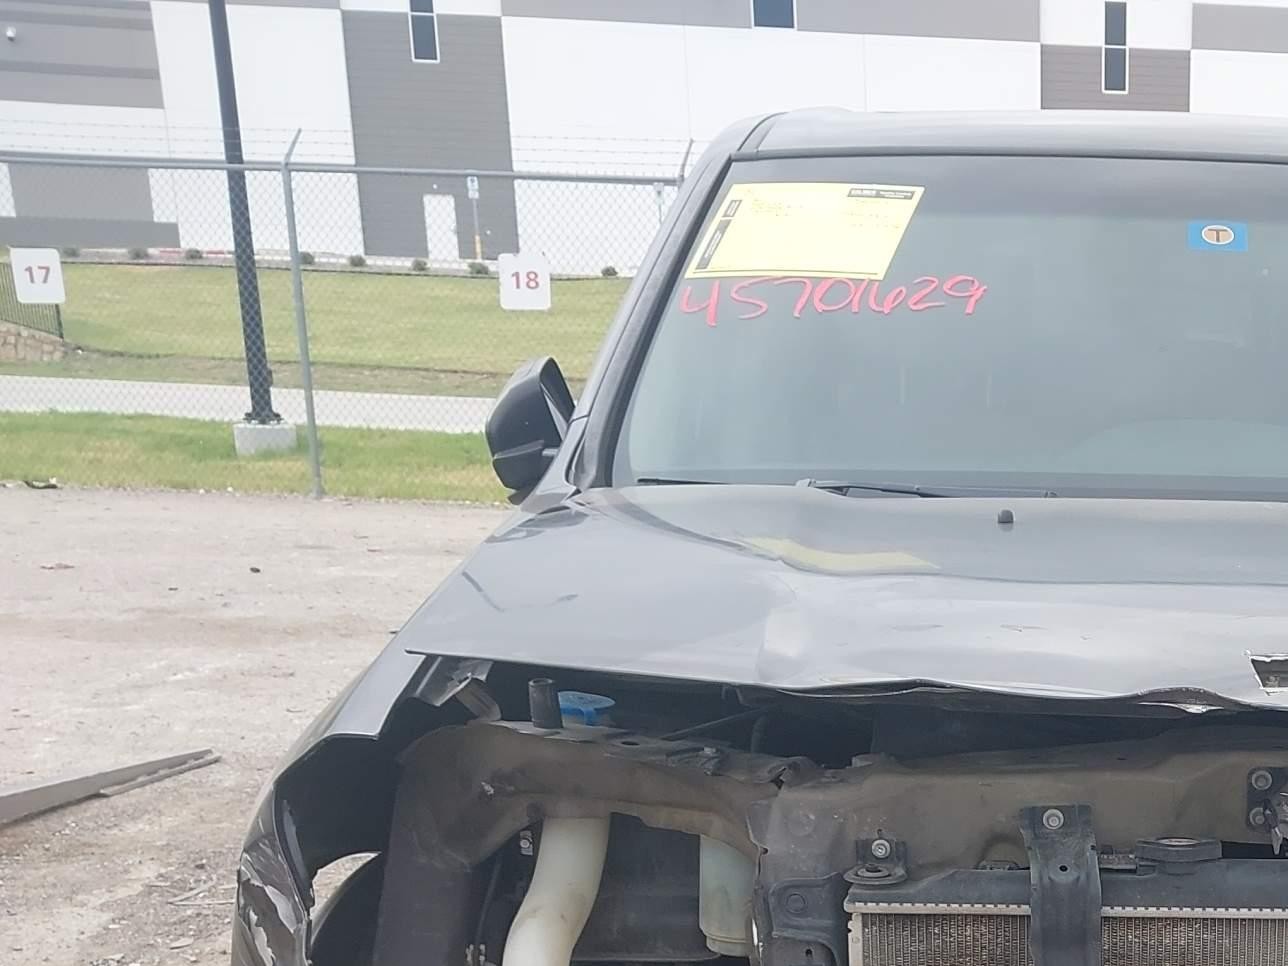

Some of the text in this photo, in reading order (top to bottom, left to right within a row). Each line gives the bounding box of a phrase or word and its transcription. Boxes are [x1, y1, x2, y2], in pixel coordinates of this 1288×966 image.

[23, 265, 50, 284] 17
[511, 270, 540, 290] 18
[680, 274, 988, 328] 45701629
